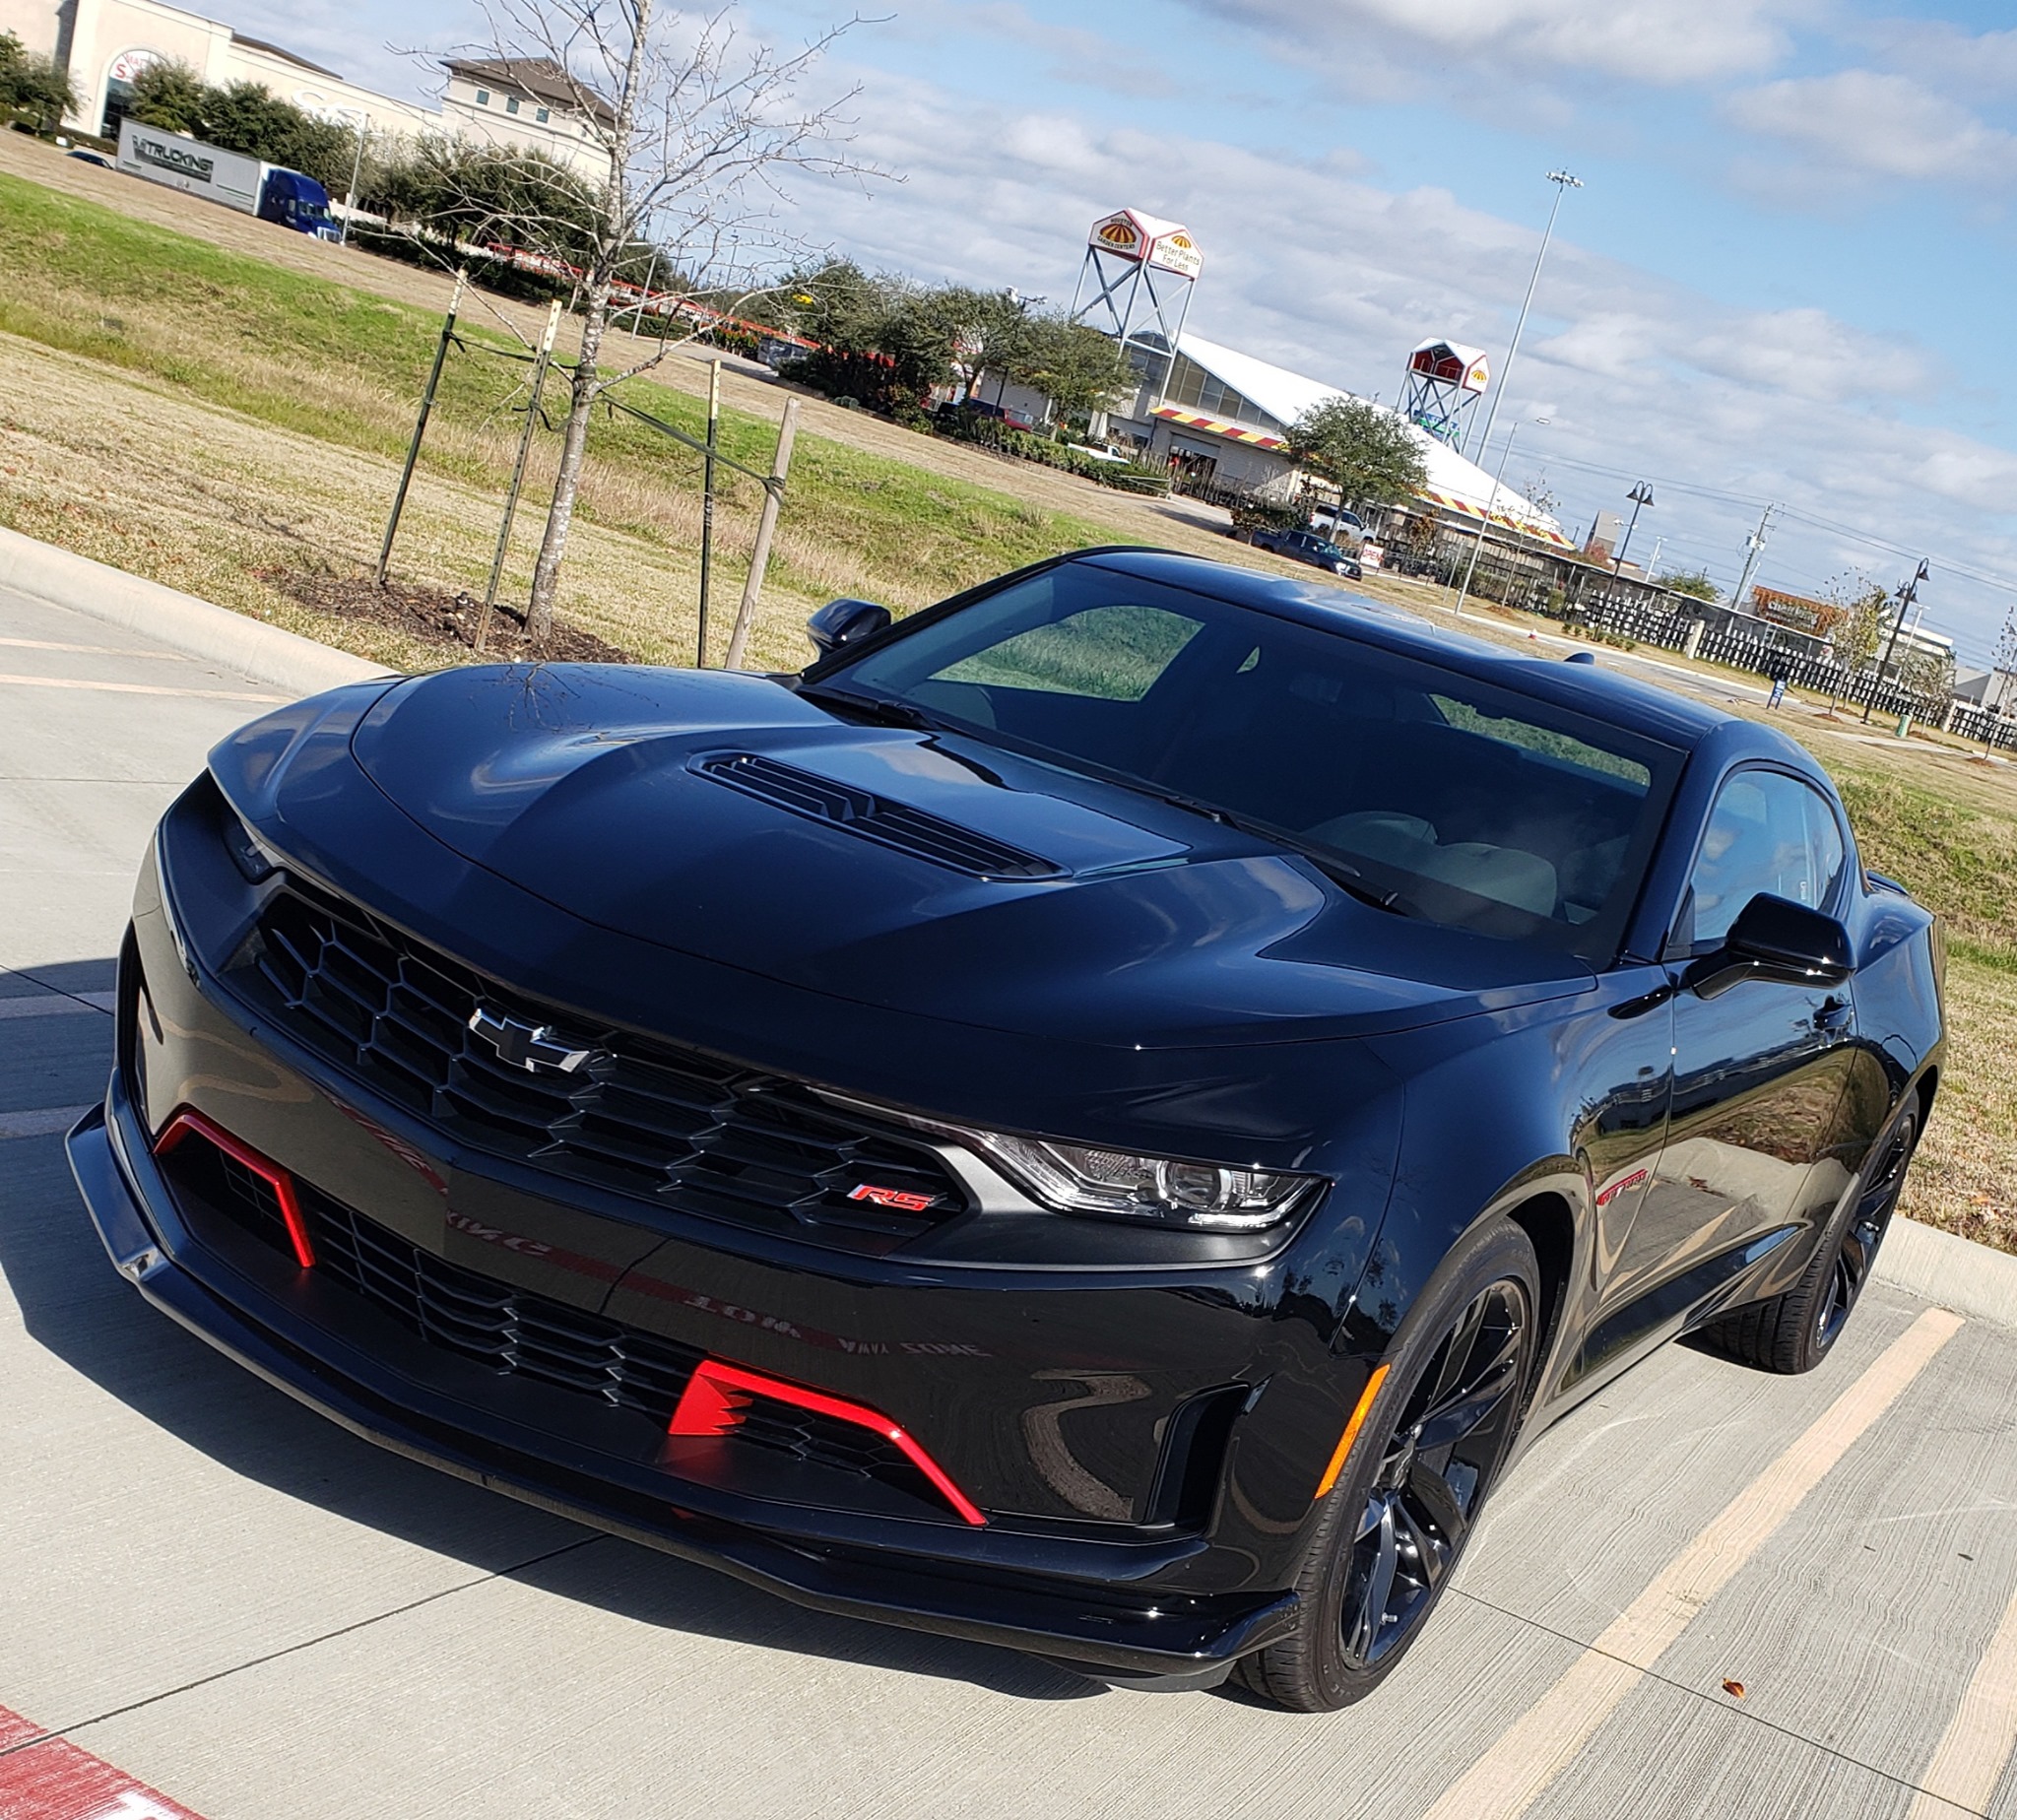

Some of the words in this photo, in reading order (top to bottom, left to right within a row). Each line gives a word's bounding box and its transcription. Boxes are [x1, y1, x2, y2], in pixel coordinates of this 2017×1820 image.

[146, 140, 214, 171] TRUCKING
[1110, 218, 1133, 228] HOUSTON
[1097, 235, 1114, 247] GARDEN
[1156, 240, 1178, 256] Better
[1178, 249, 1200, 265] Plants
[1162, 254, 1174, 265] For
[1174, 259, 1189, 271] Less
[847, 1183, 934, 1211] RS
